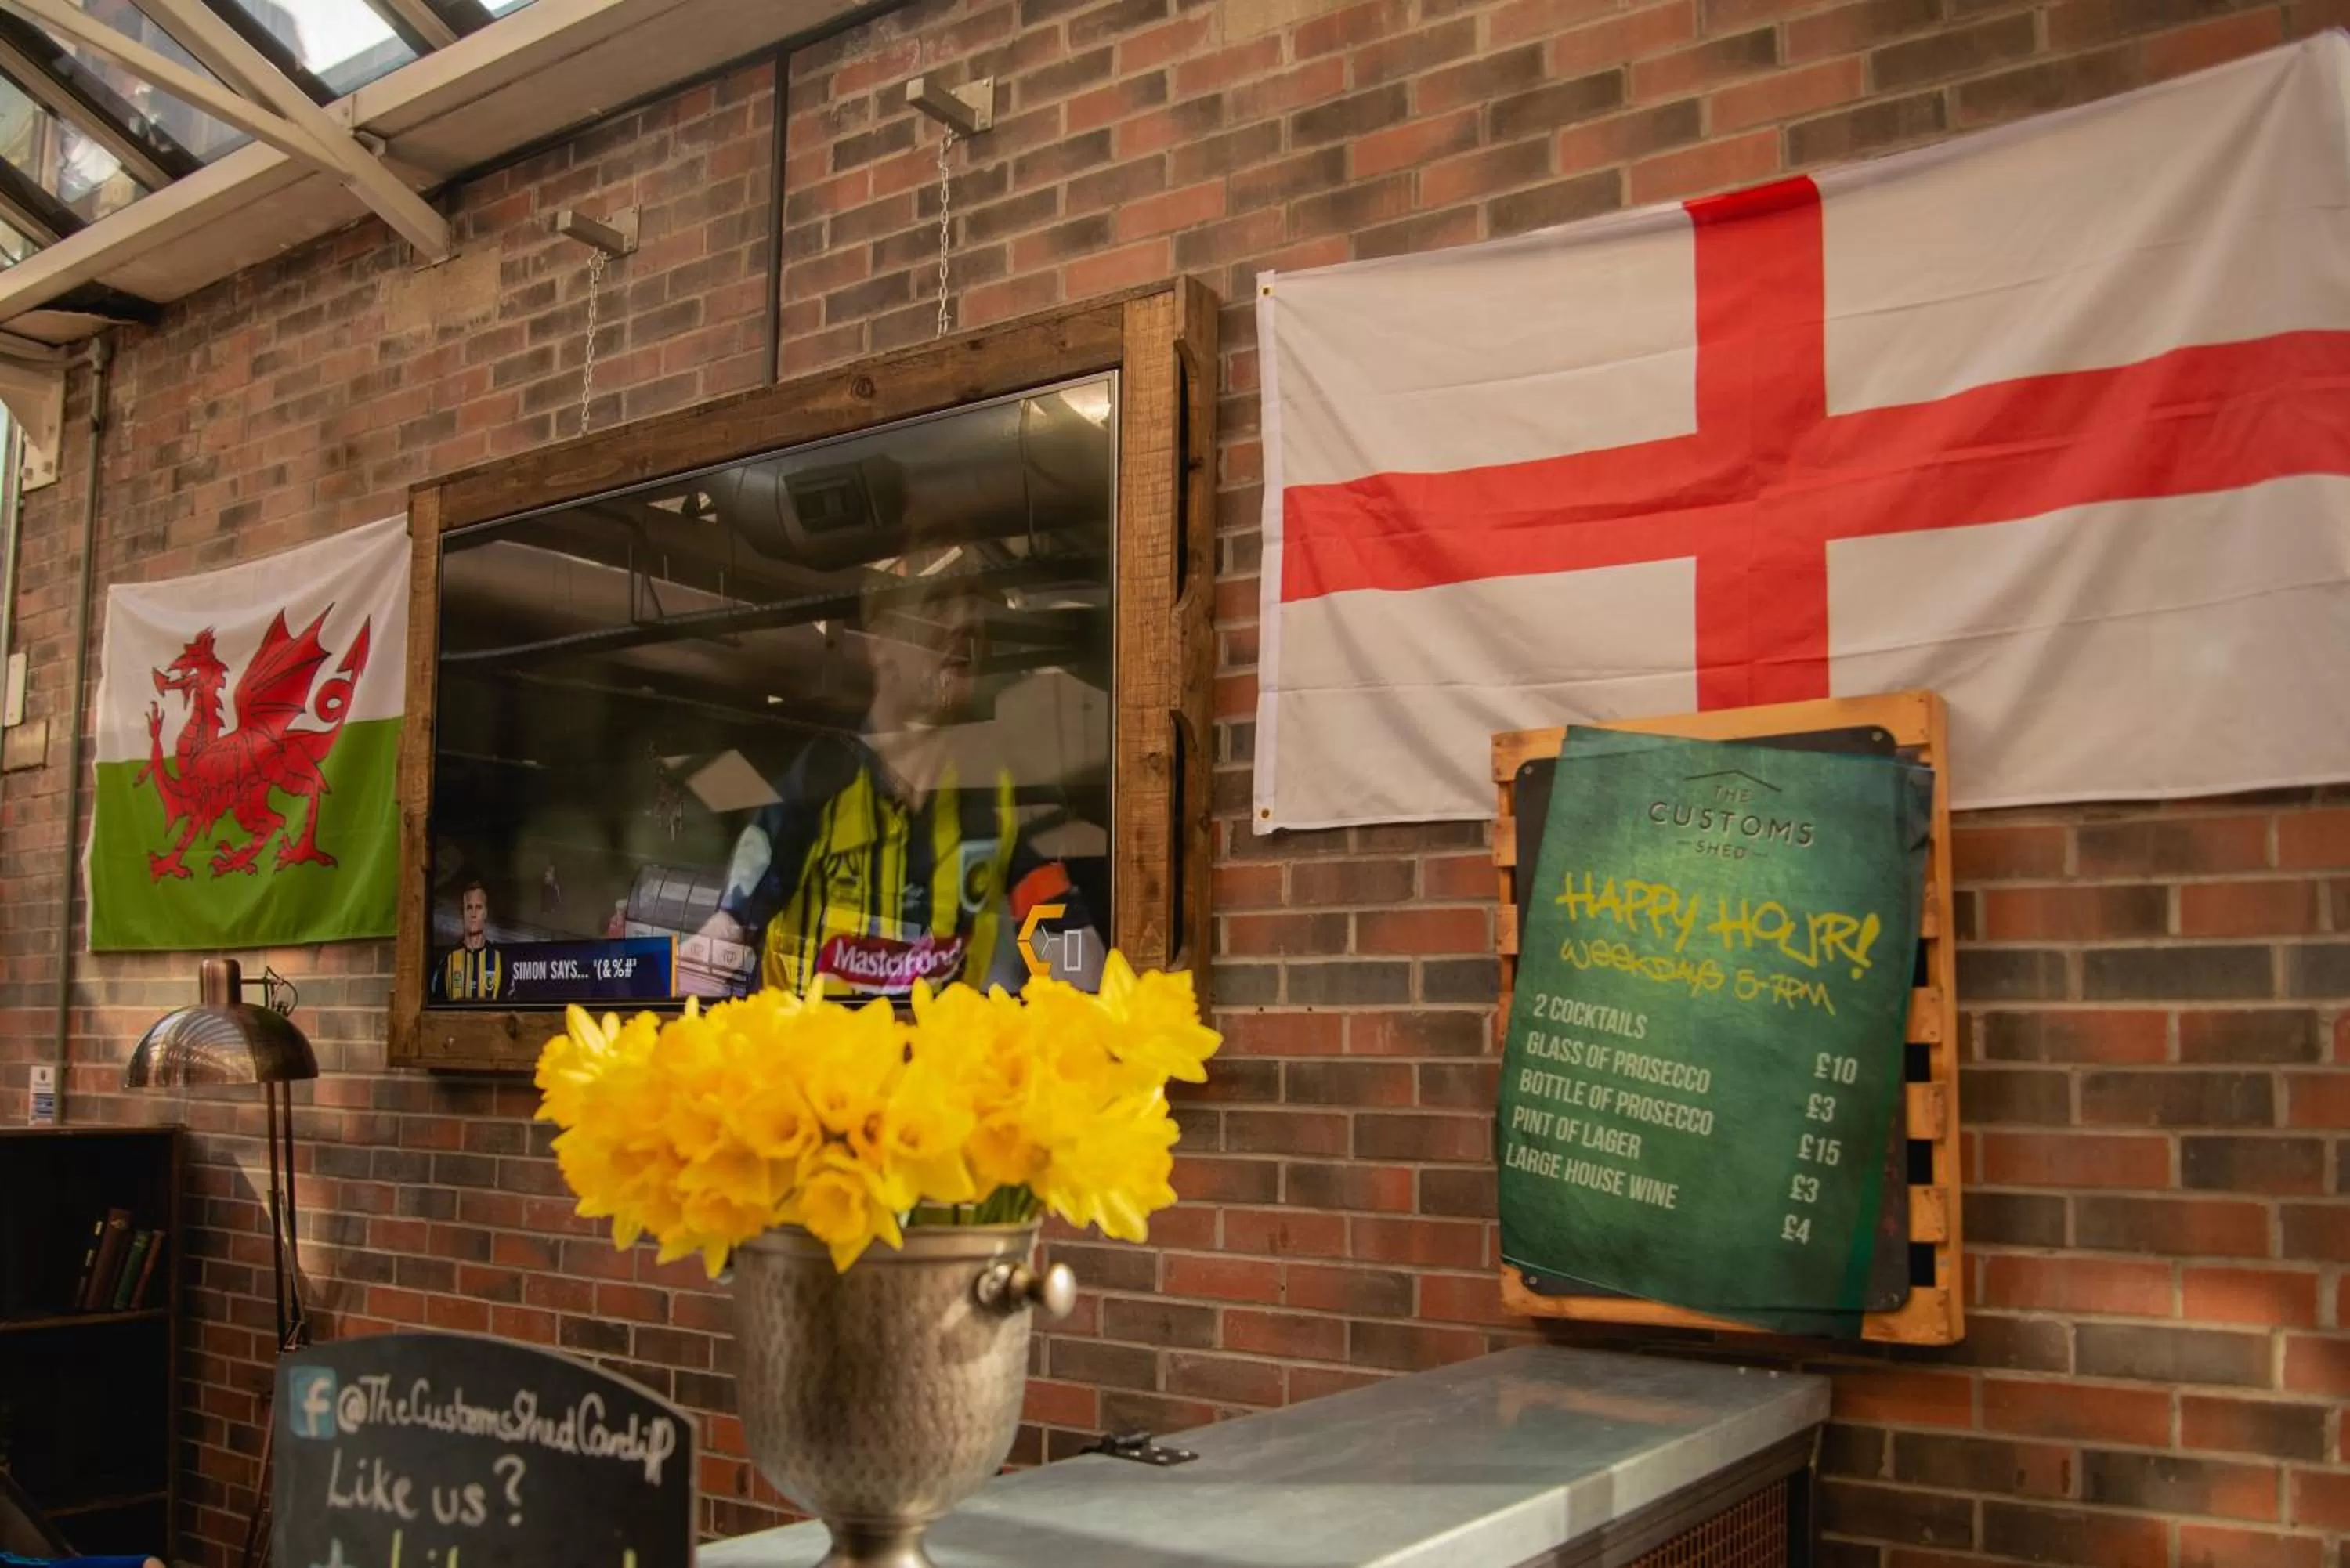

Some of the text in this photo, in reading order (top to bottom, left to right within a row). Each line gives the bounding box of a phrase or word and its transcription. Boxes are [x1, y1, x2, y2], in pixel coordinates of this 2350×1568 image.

[1714, 786, 1752, 803] THE
[1648, 800, 1815, 848] CUSTOMS
[1694, 839, 1748, 860] SHED
[1555, 872, 1879, 979] HAPPY HOUR!
[512, 961, 547, 980] SIMON
[551, 959, 589, 980] SAYS...
[1533, 993, 1648, 1040] 2 COCKTAILS
[1527, 1031, 1711, 1094] GLASS OF PROSECCO
[1813, 1053, 1858, 1086] £10
[1519, 1068, 1714, 1136] BOTTLE OF PROSECCO
[1806, 1093, 1836, 1123] £3
[1512, 1106, 1642, 1161] PINT OF LAGER
[1799, 1133, 1842, 1168] £15
[1505, 1143, 1679, 1210] LARGE HOUSE WINE
[1788, 1175, 1819, 1204] £3
[1781, 1214, 1813, 1245] £4
[327, 1447, 418, 1520] Like
